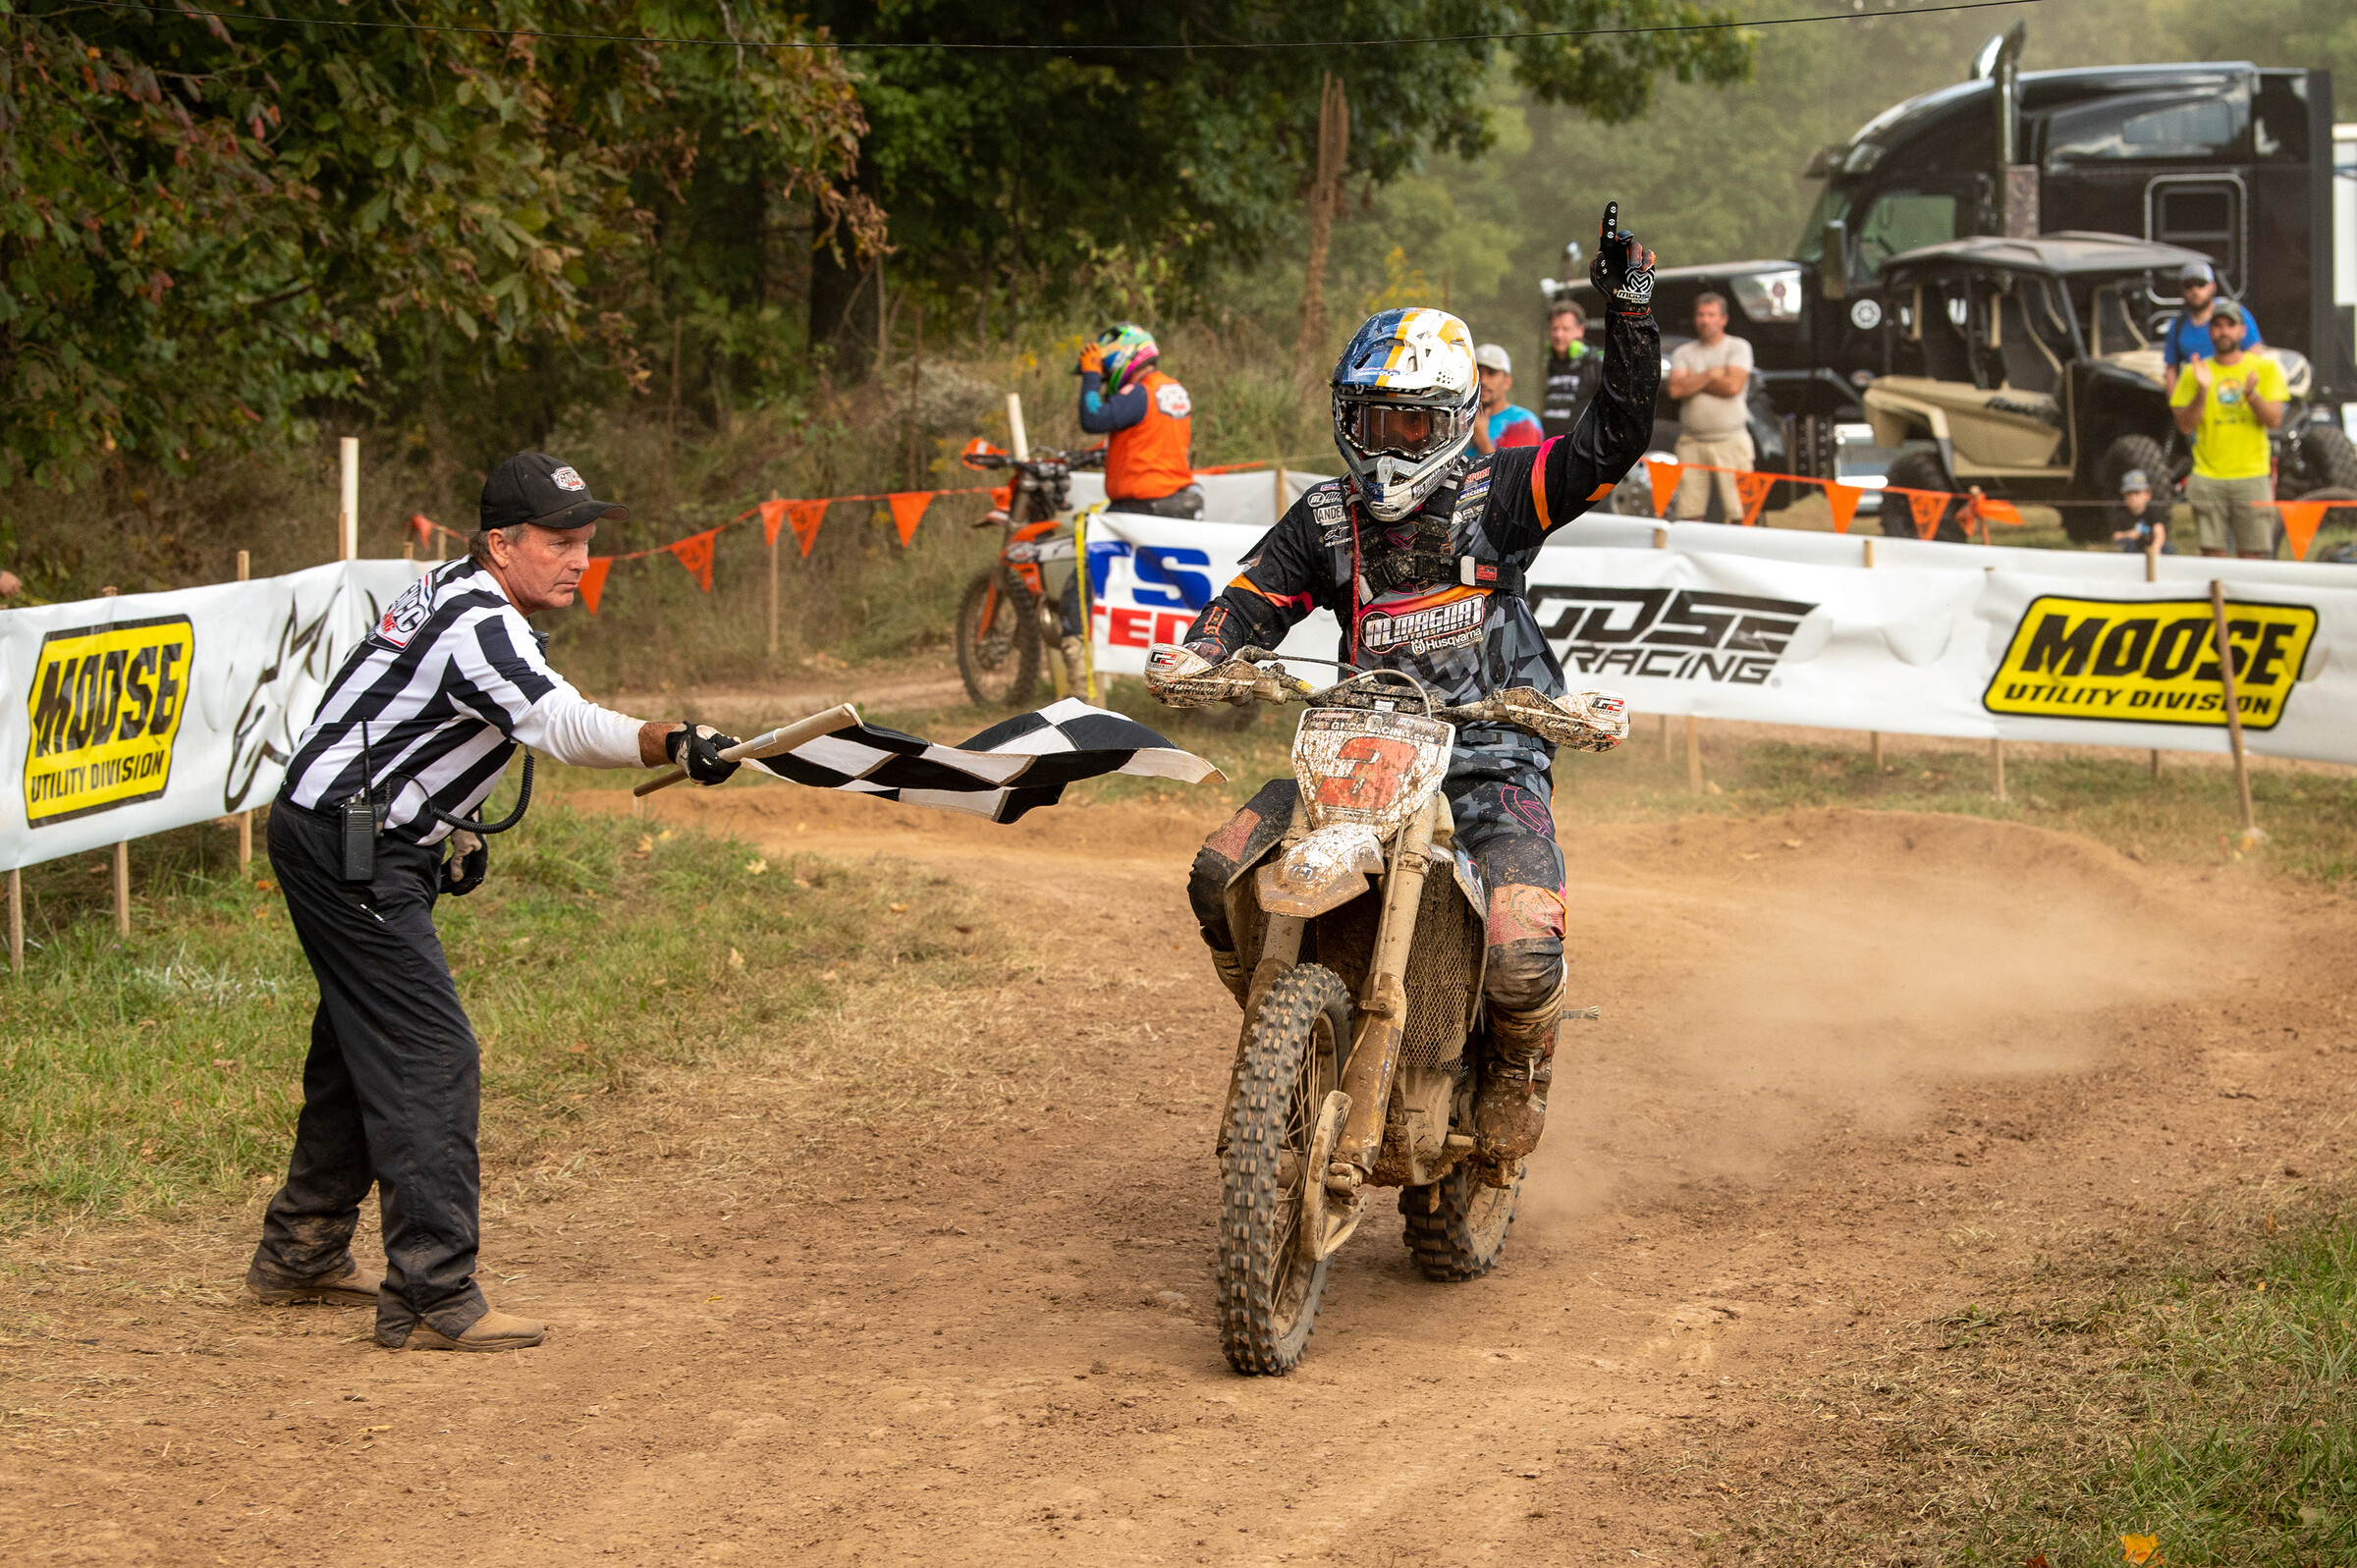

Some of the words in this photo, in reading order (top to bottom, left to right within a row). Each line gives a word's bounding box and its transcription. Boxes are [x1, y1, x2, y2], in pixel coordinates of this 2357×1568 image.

[1394, 620, 1471, 643] MOTORSPORTS
[1425, 627, 1483, 651] Husqvarna
[2020, 613, 2298, 686] MOOSE
[1560, 644, 1780, 685] RACING
[33, 642, 184, 758] MOOSE
[2005, 683, 2123, 706] UTILITY
[31, 766, 86, 803] UTILITY
[90, 750, 165, 790] DIVISION
[1316, 736, 1418, 810] 3
